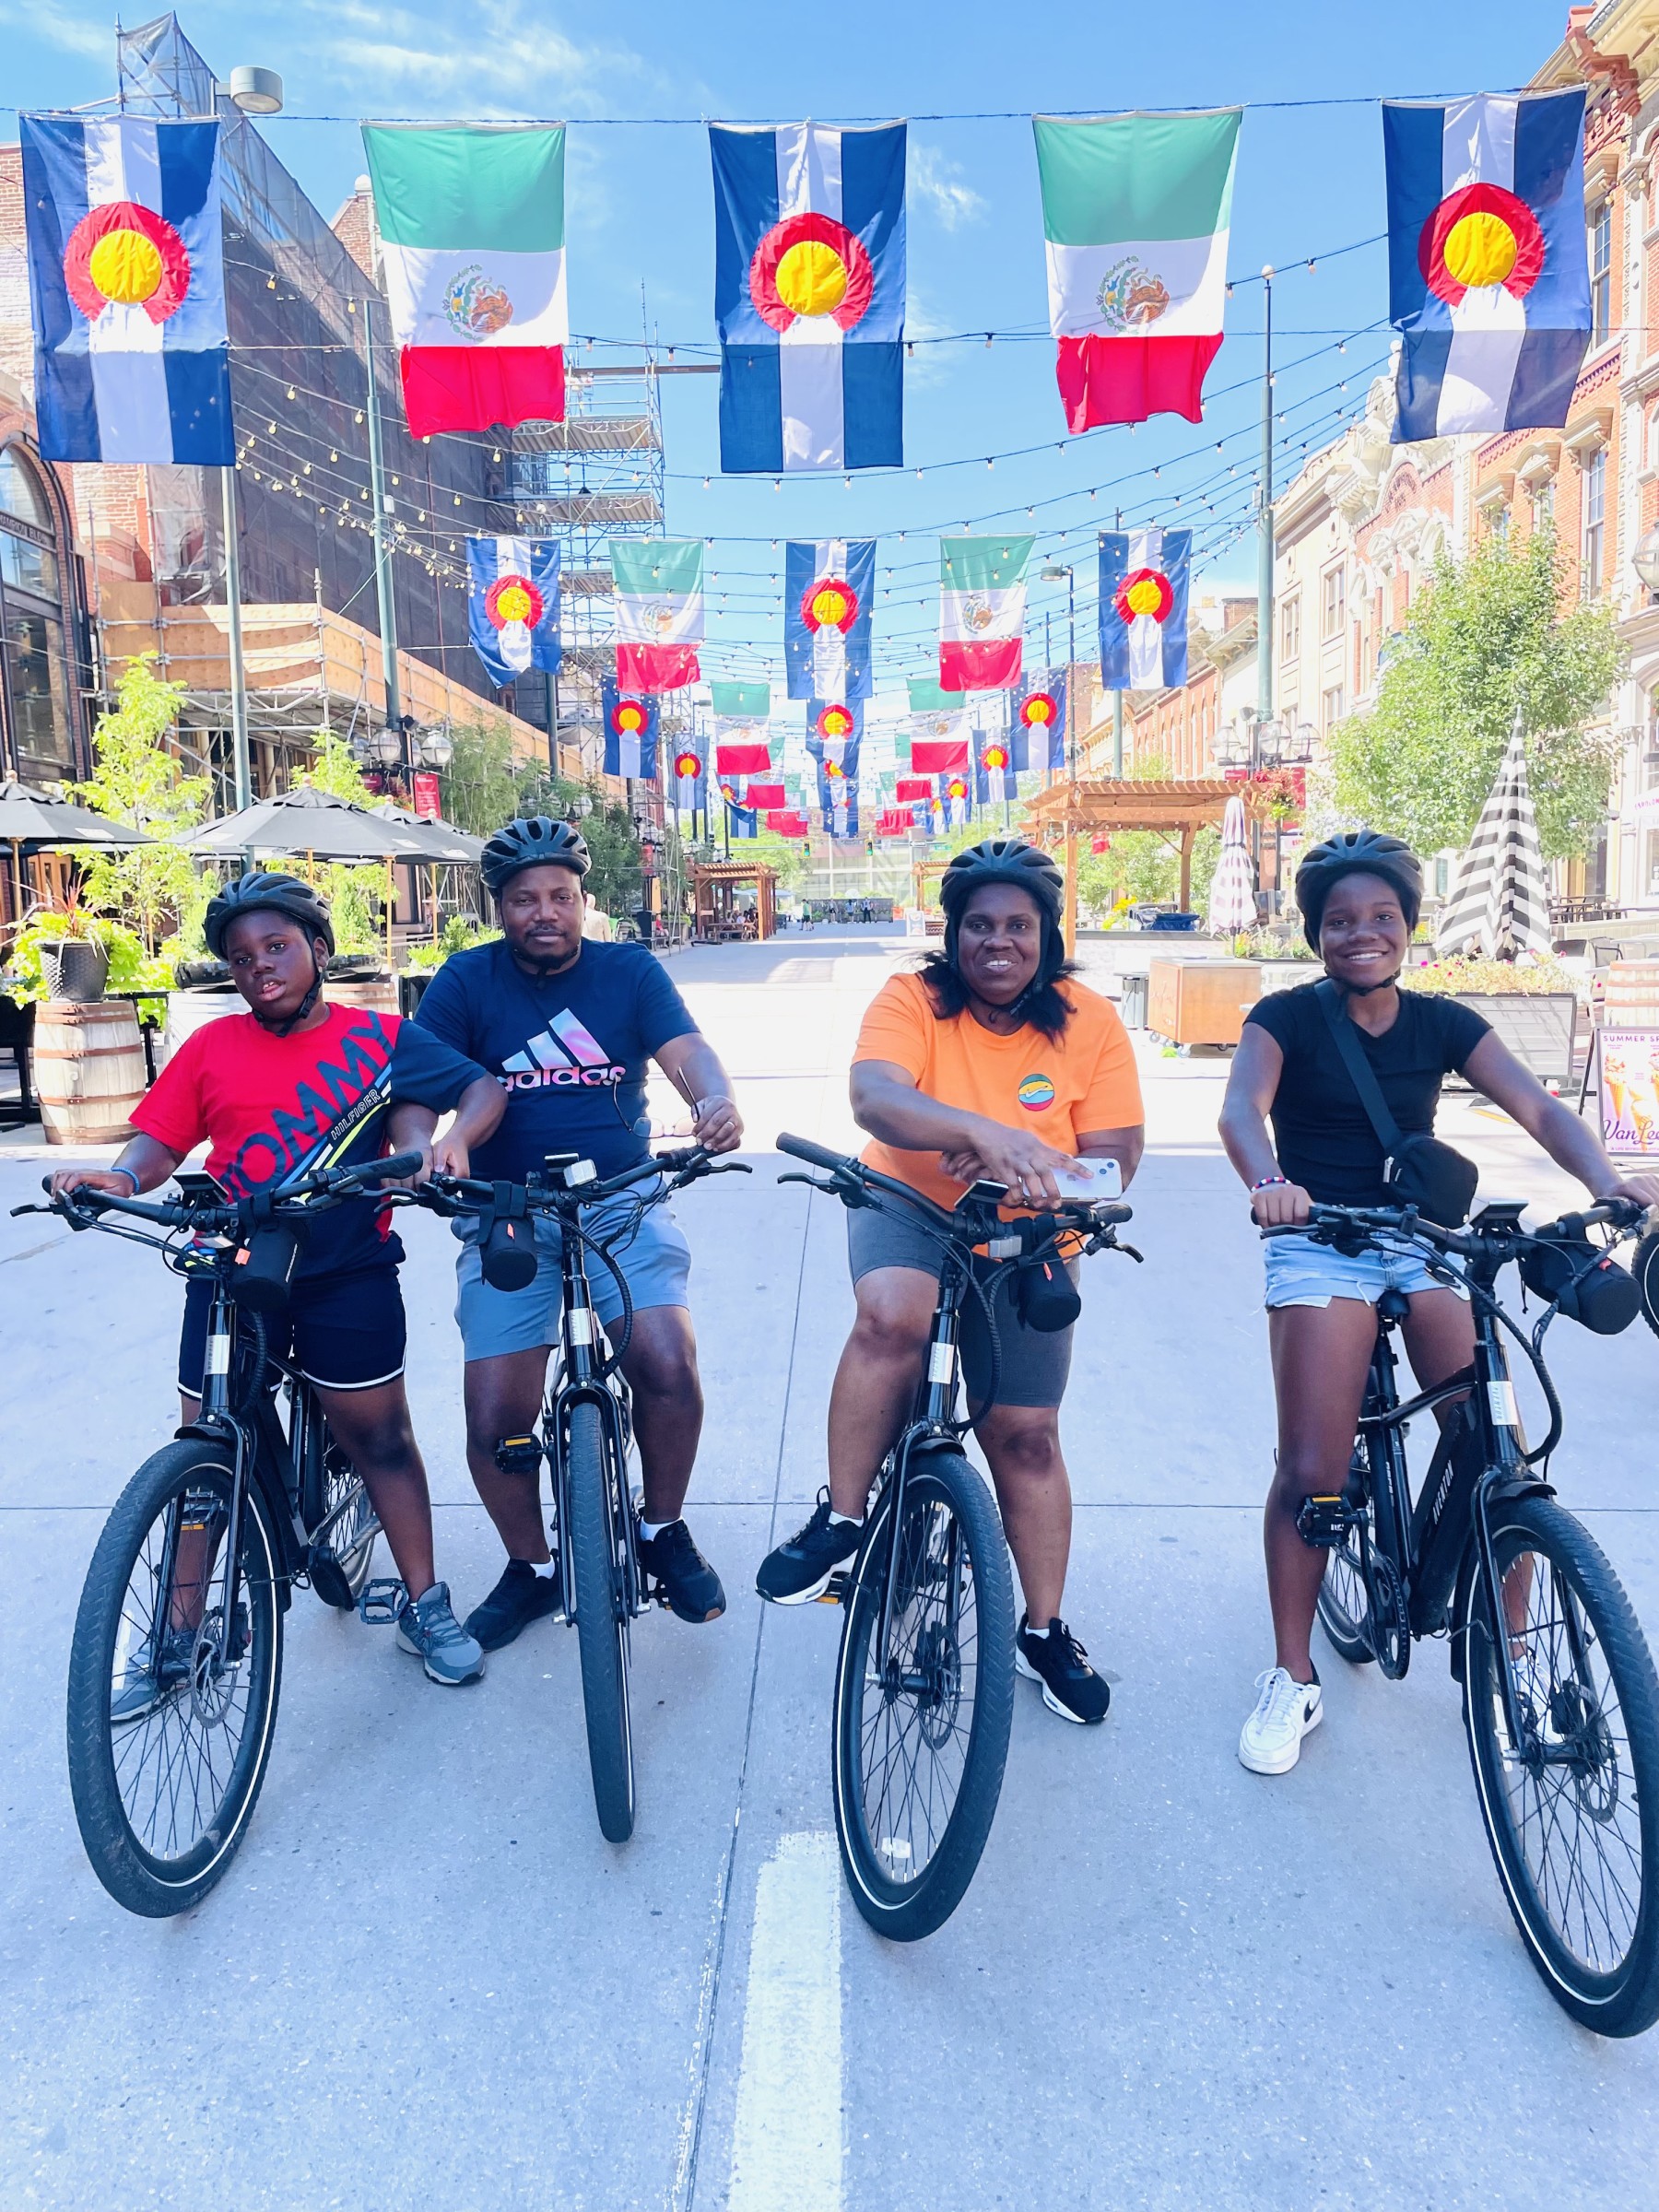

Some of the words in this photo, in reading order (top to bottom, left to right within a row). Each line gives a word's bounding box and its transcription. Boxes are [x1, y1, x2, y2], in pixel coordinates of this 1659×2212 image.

[496, 1066, 626, 1092] adidas
[330, 1088, 381, 1140] HILFIGER
[1603, 1119, 1638, 1140] Van
[1432, 1459, 1454, 1525] AVENTON
